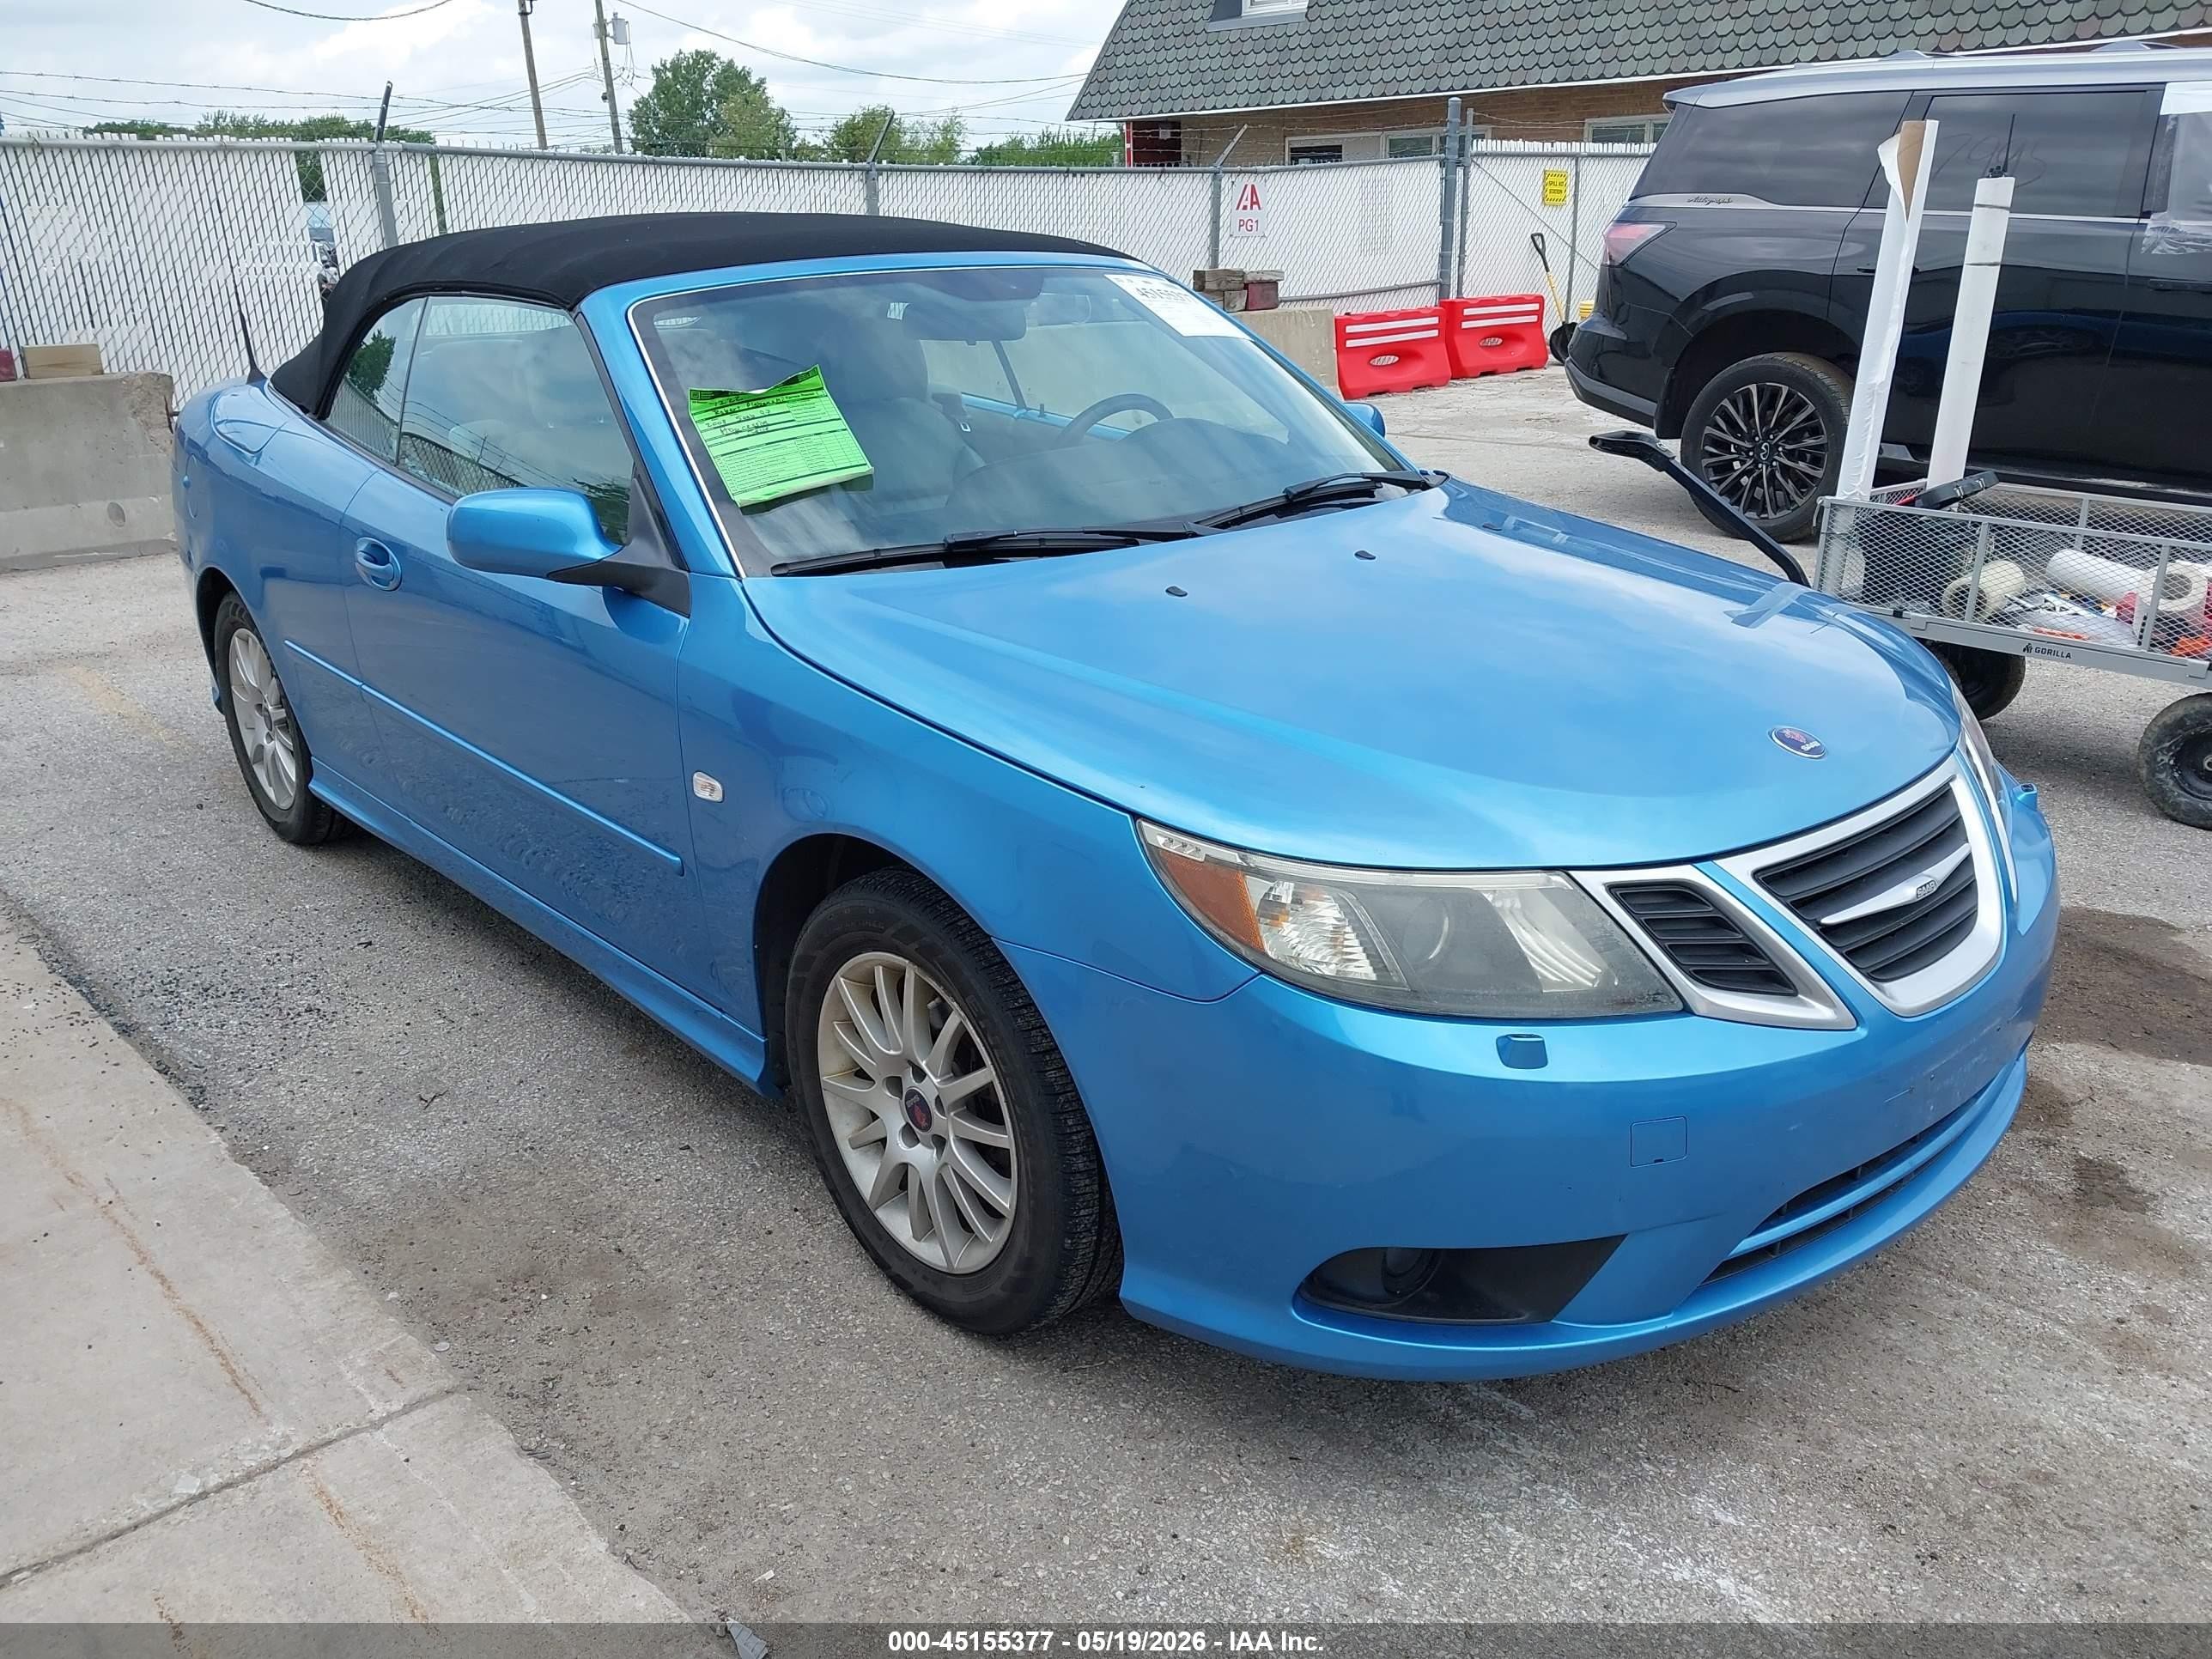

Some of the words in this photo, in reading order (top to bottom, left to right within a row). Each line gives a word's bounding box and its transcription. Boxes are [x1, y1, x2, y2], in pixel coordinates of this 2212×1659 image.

[1238, 218, 1259, 232] PG1
[2034, 646, 2072, 659] GORILLA
[1917, 879, 1937, 898] SAAB
